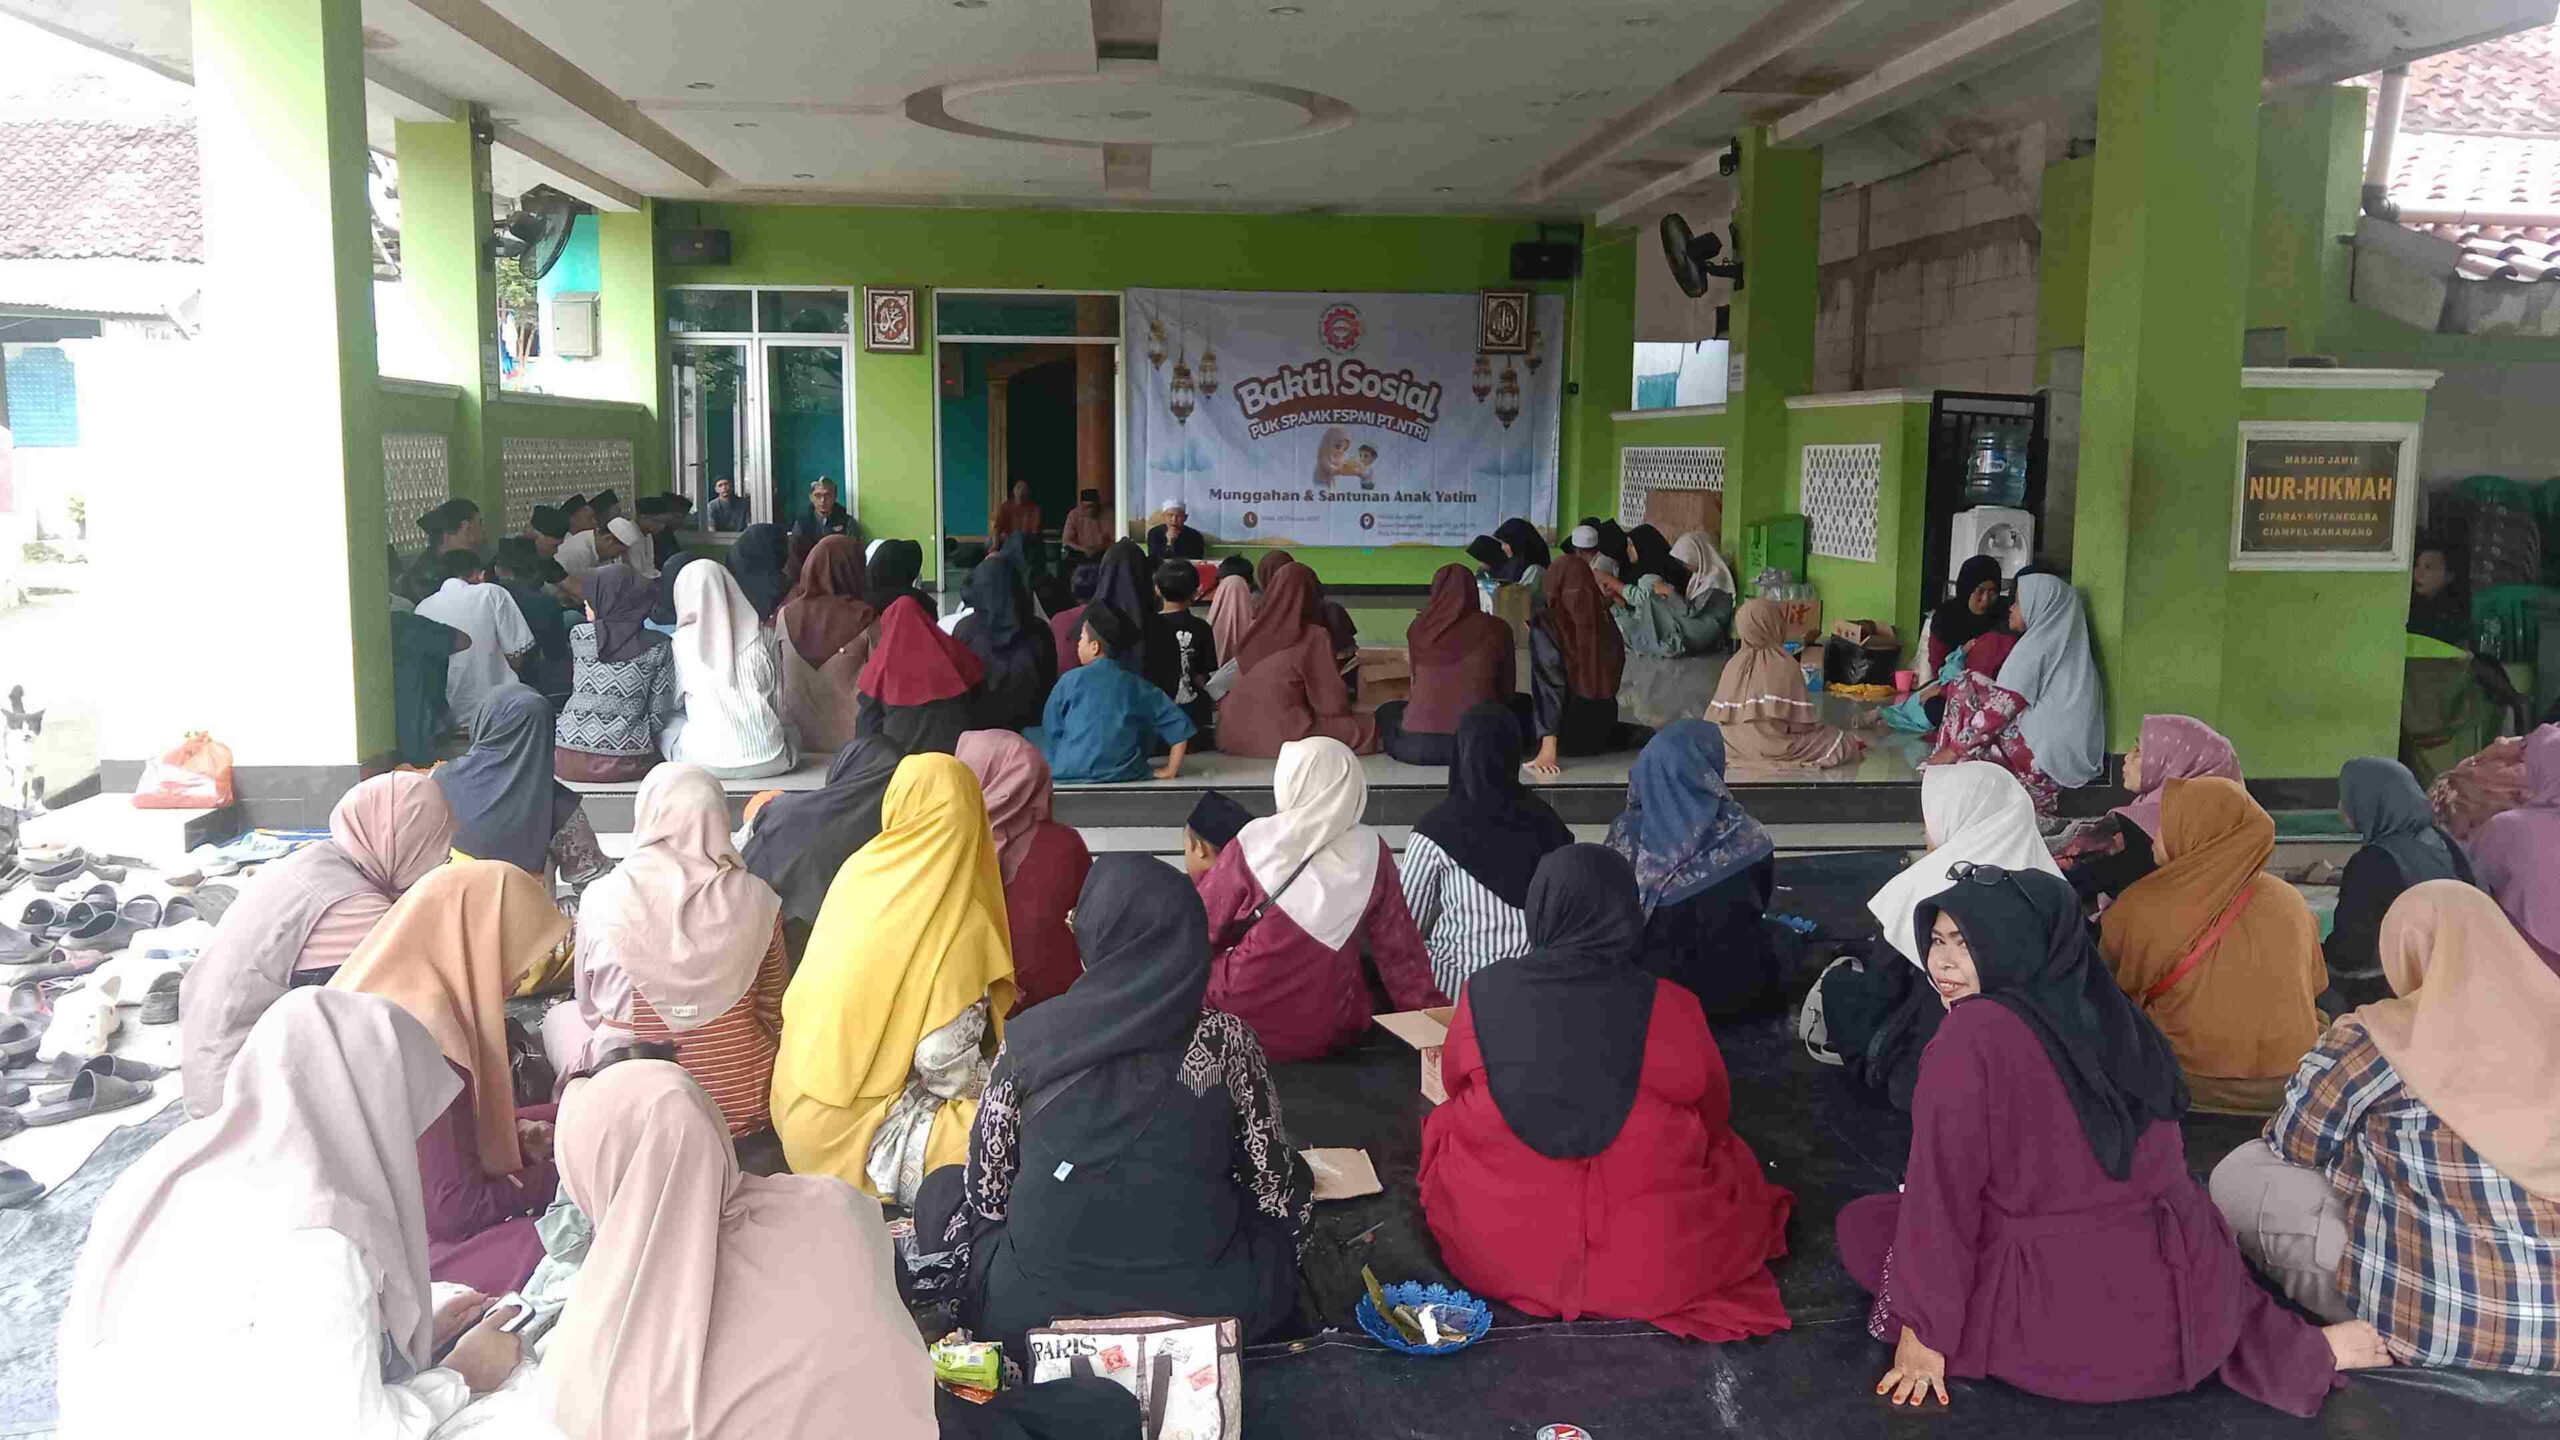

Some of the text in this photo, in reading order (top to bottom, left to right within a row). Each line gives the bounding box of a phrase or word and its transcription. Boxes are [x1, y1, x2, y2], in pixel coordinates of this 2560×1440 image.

[1236, 361, 1441, 419] Bakti Sosial
[1250, 420, 1280, 439] PUK
[1281, 409, 1331, 428] SPAMK
[1332, 409, 1375, 425] FSPMI
[2284, 455, 2360, 465] MASJID JAMIE
[1209, 488, 1477, 504] Munggahan & Santunan Anak Yatim
[2249, 476, 2393, 500] NUR-HIKMAH
[1033, 1336, 1098, 1361] PARIS
